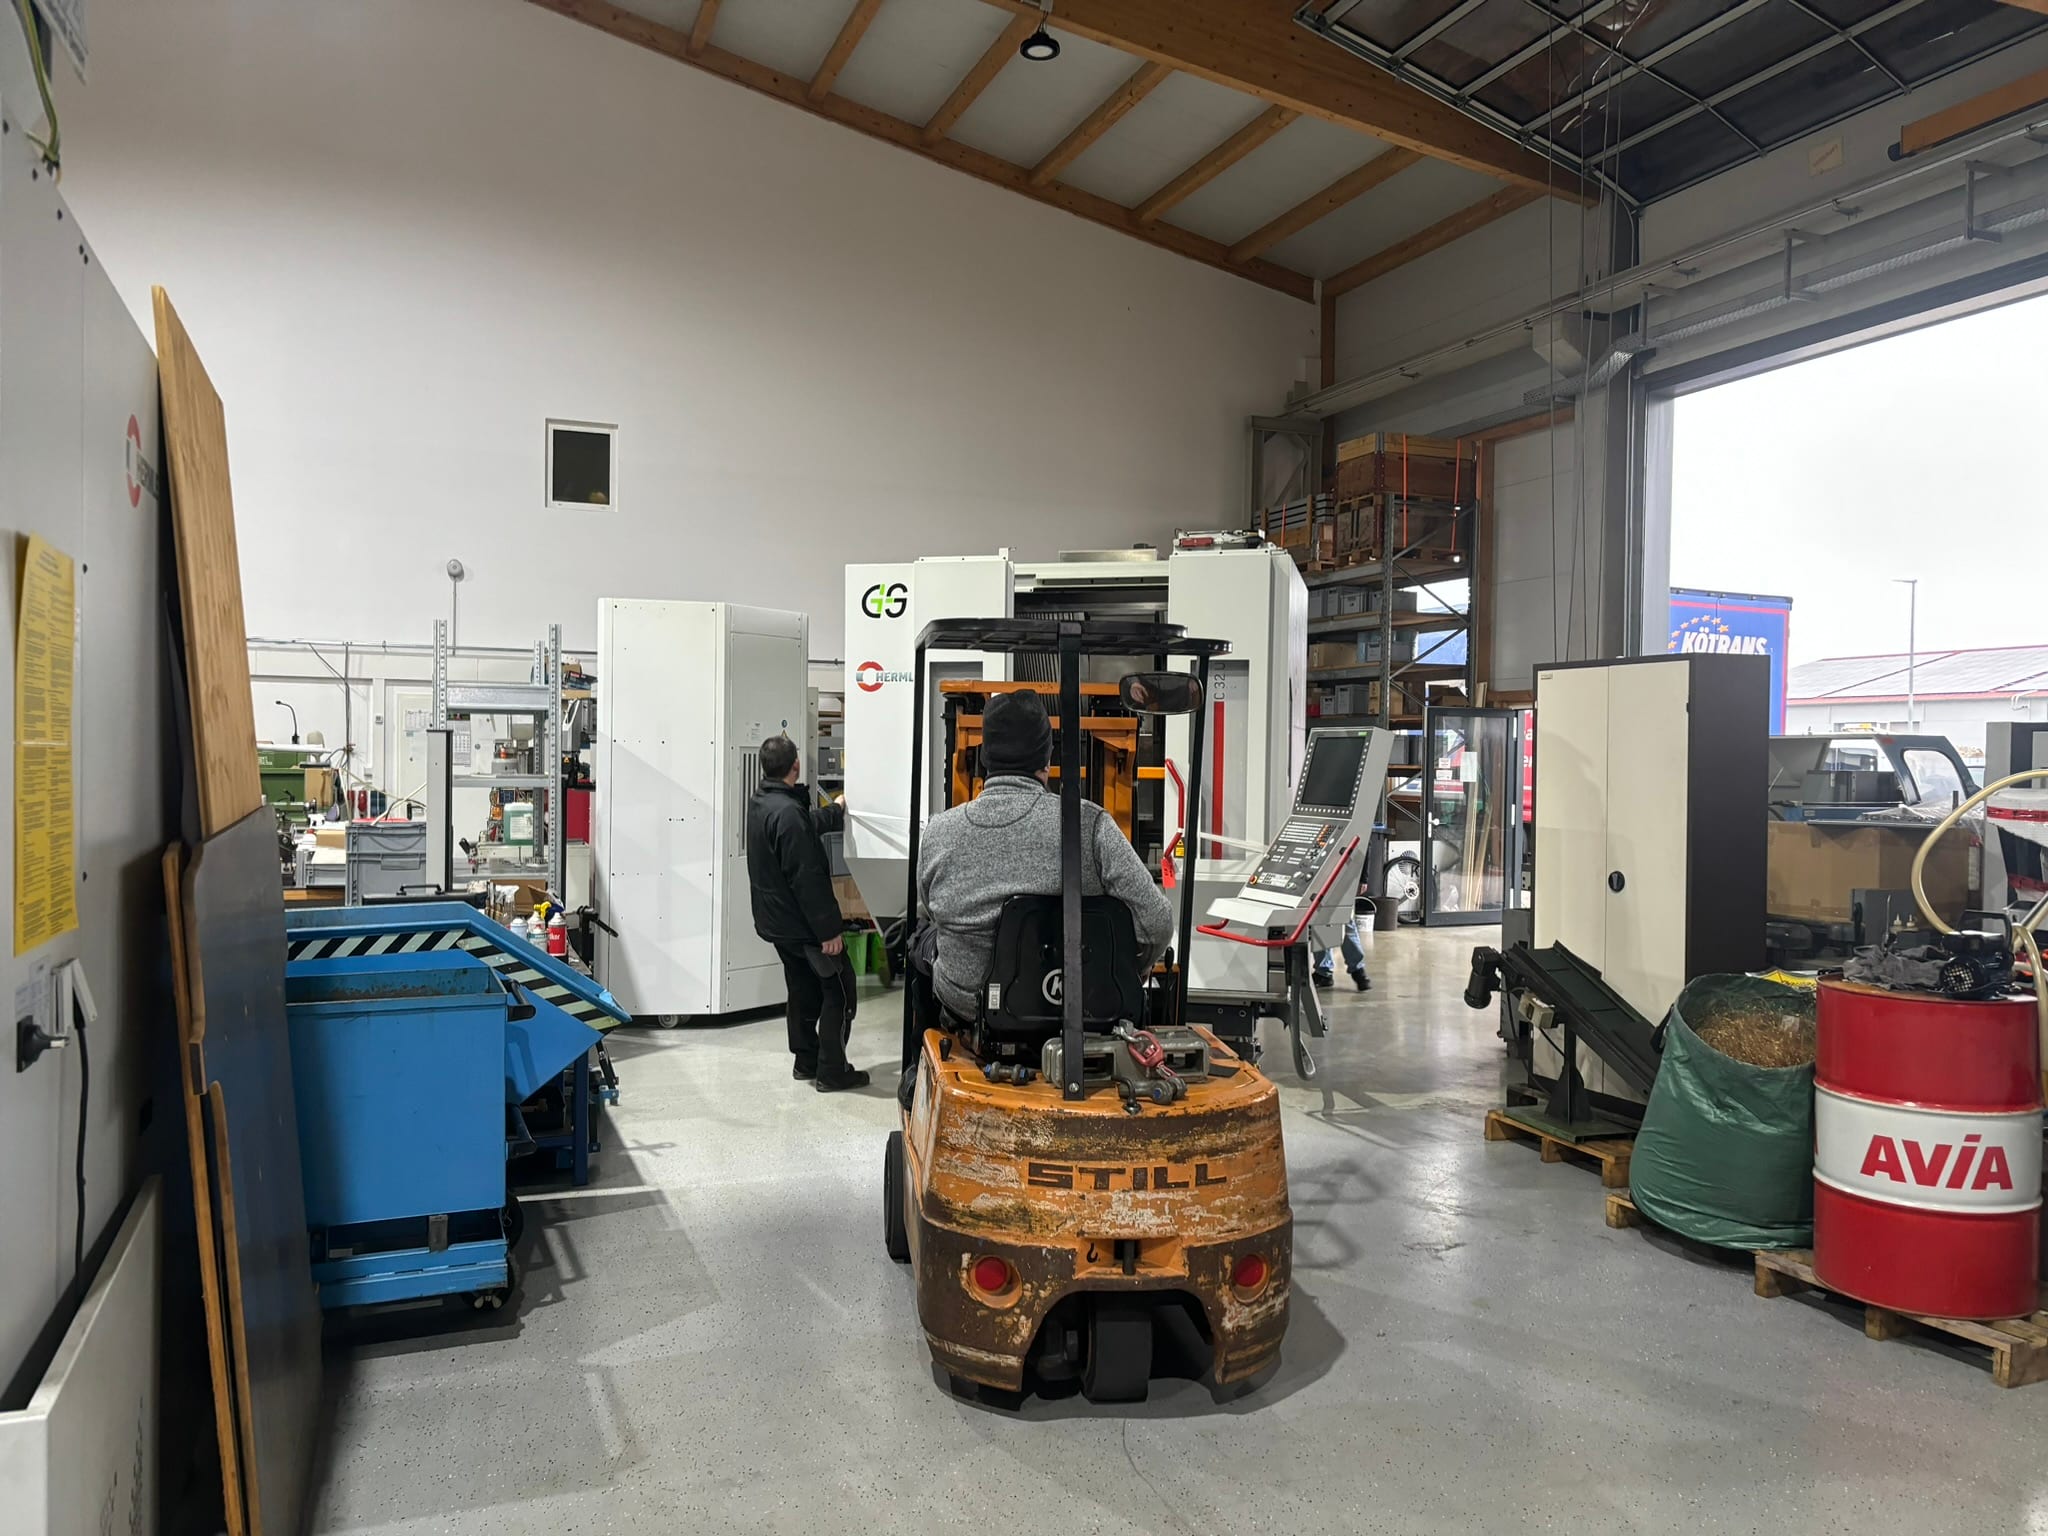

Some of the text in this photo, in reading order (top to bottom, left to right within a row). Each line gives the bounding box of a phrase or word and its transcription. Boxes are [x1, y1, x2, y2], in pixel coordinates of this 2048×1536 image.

[1681, 627, 1768, 655] KÖTRANS
[1214, 673, 1225, 689] 32
[1028, 1161, 1227, 1191] STILL
